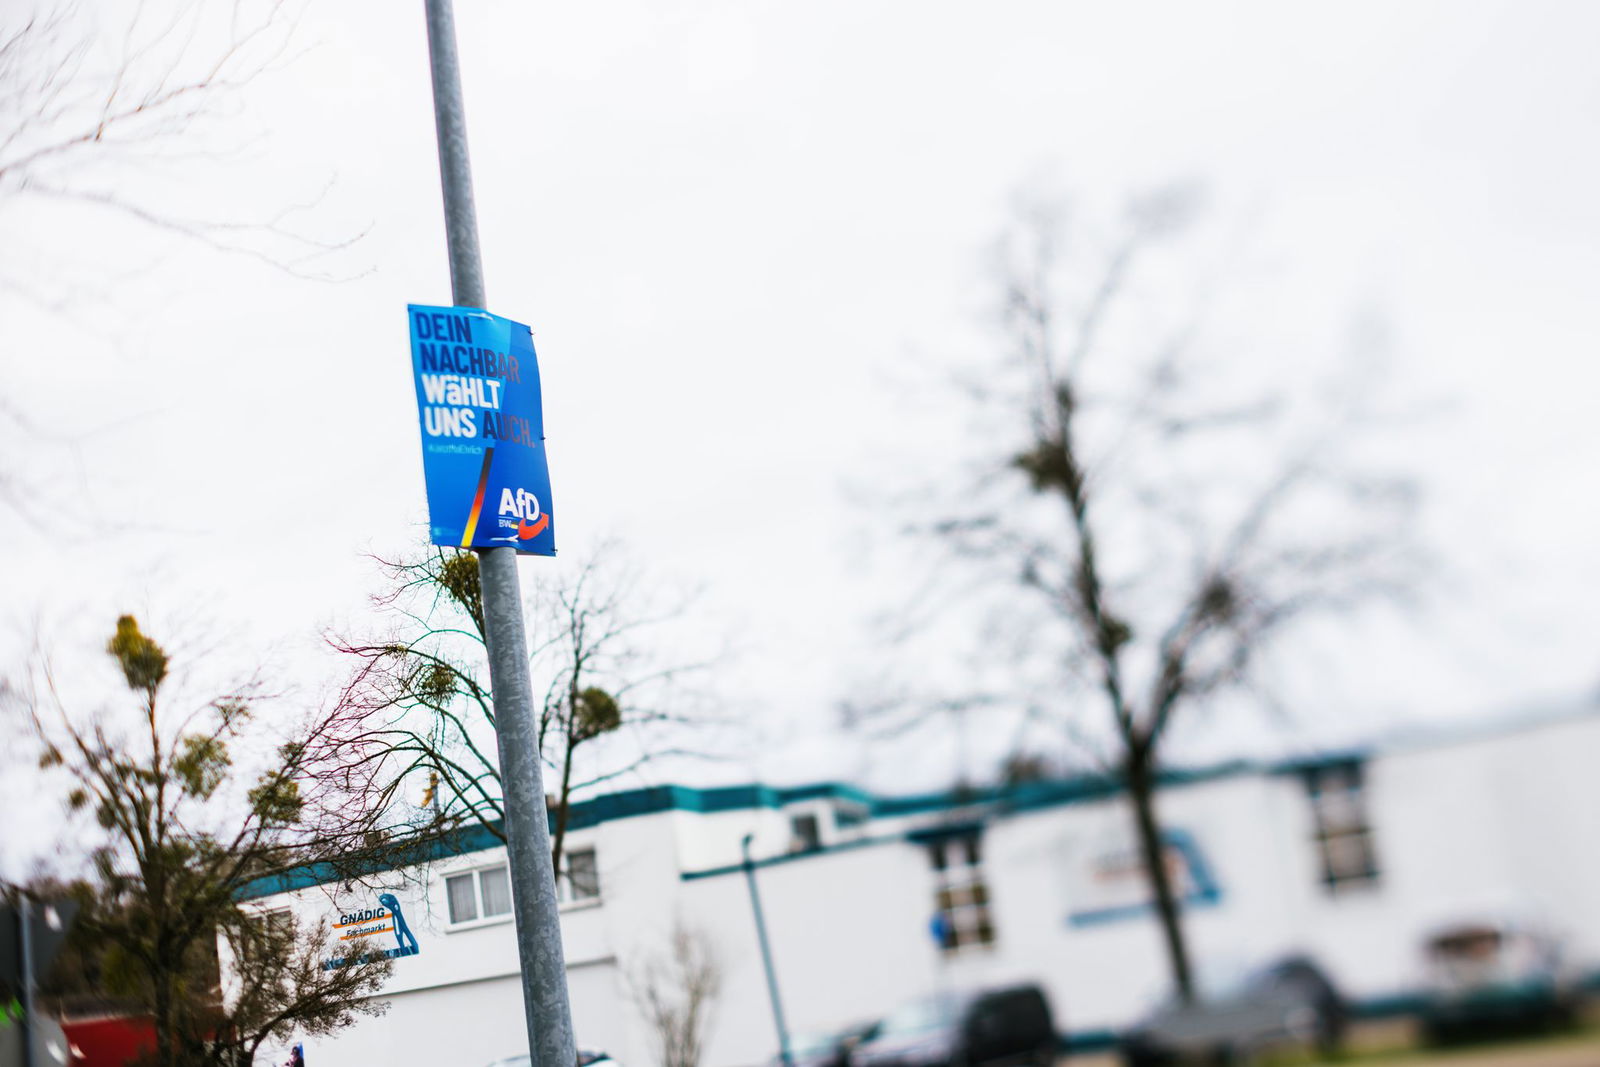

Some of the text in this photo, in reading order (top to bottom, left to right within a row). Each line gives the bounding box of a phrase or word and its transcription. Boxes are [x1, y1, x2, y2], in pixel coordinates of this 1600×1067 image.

[415, 312, 472, 343] DEIN
[420, 342, 520, 383] NACHBAR
[425, 406, 536, 448] UNS AUCH.
[498, 487, 540, 520] AfD
[340, 908, 385, 925] GNÄDIG
[346, 923, 385, 937] Fachmarkt
